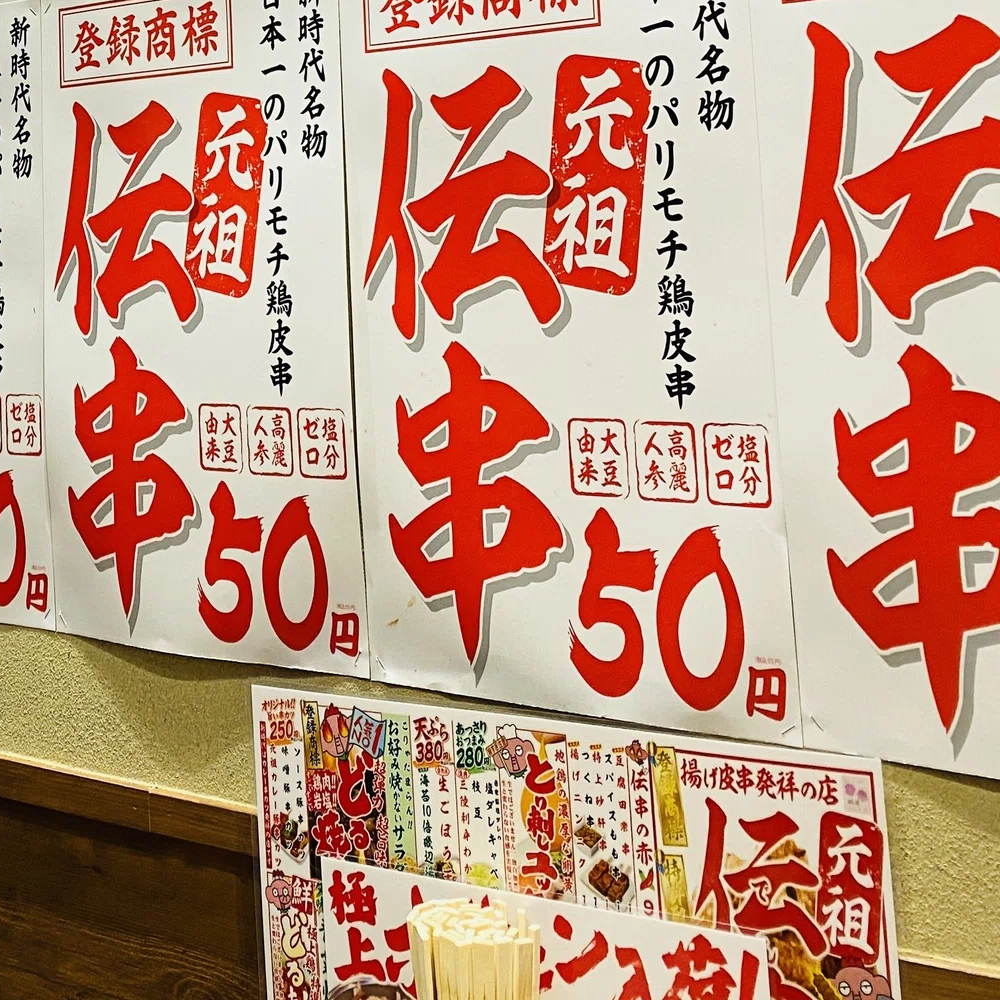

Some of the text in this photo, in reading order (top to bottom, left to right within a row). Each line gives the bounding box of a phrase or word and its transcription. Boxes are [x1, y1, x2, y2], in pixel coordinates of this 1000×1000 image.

[72, 0, 218, 72] 登録商標
[9, 16, 32, 179] 新時代名物
[191, 106, 253, 280] 元祖
[549, 71, 632, 275] 元祖
[413, 716, 449, 741] 天ぷら
[681, 757, 840, 805] 揚げ皮串発祥の店
[485, 782, 499, 879] 塩ダレキャベ
[822, 823, 875, 955] 元祖
